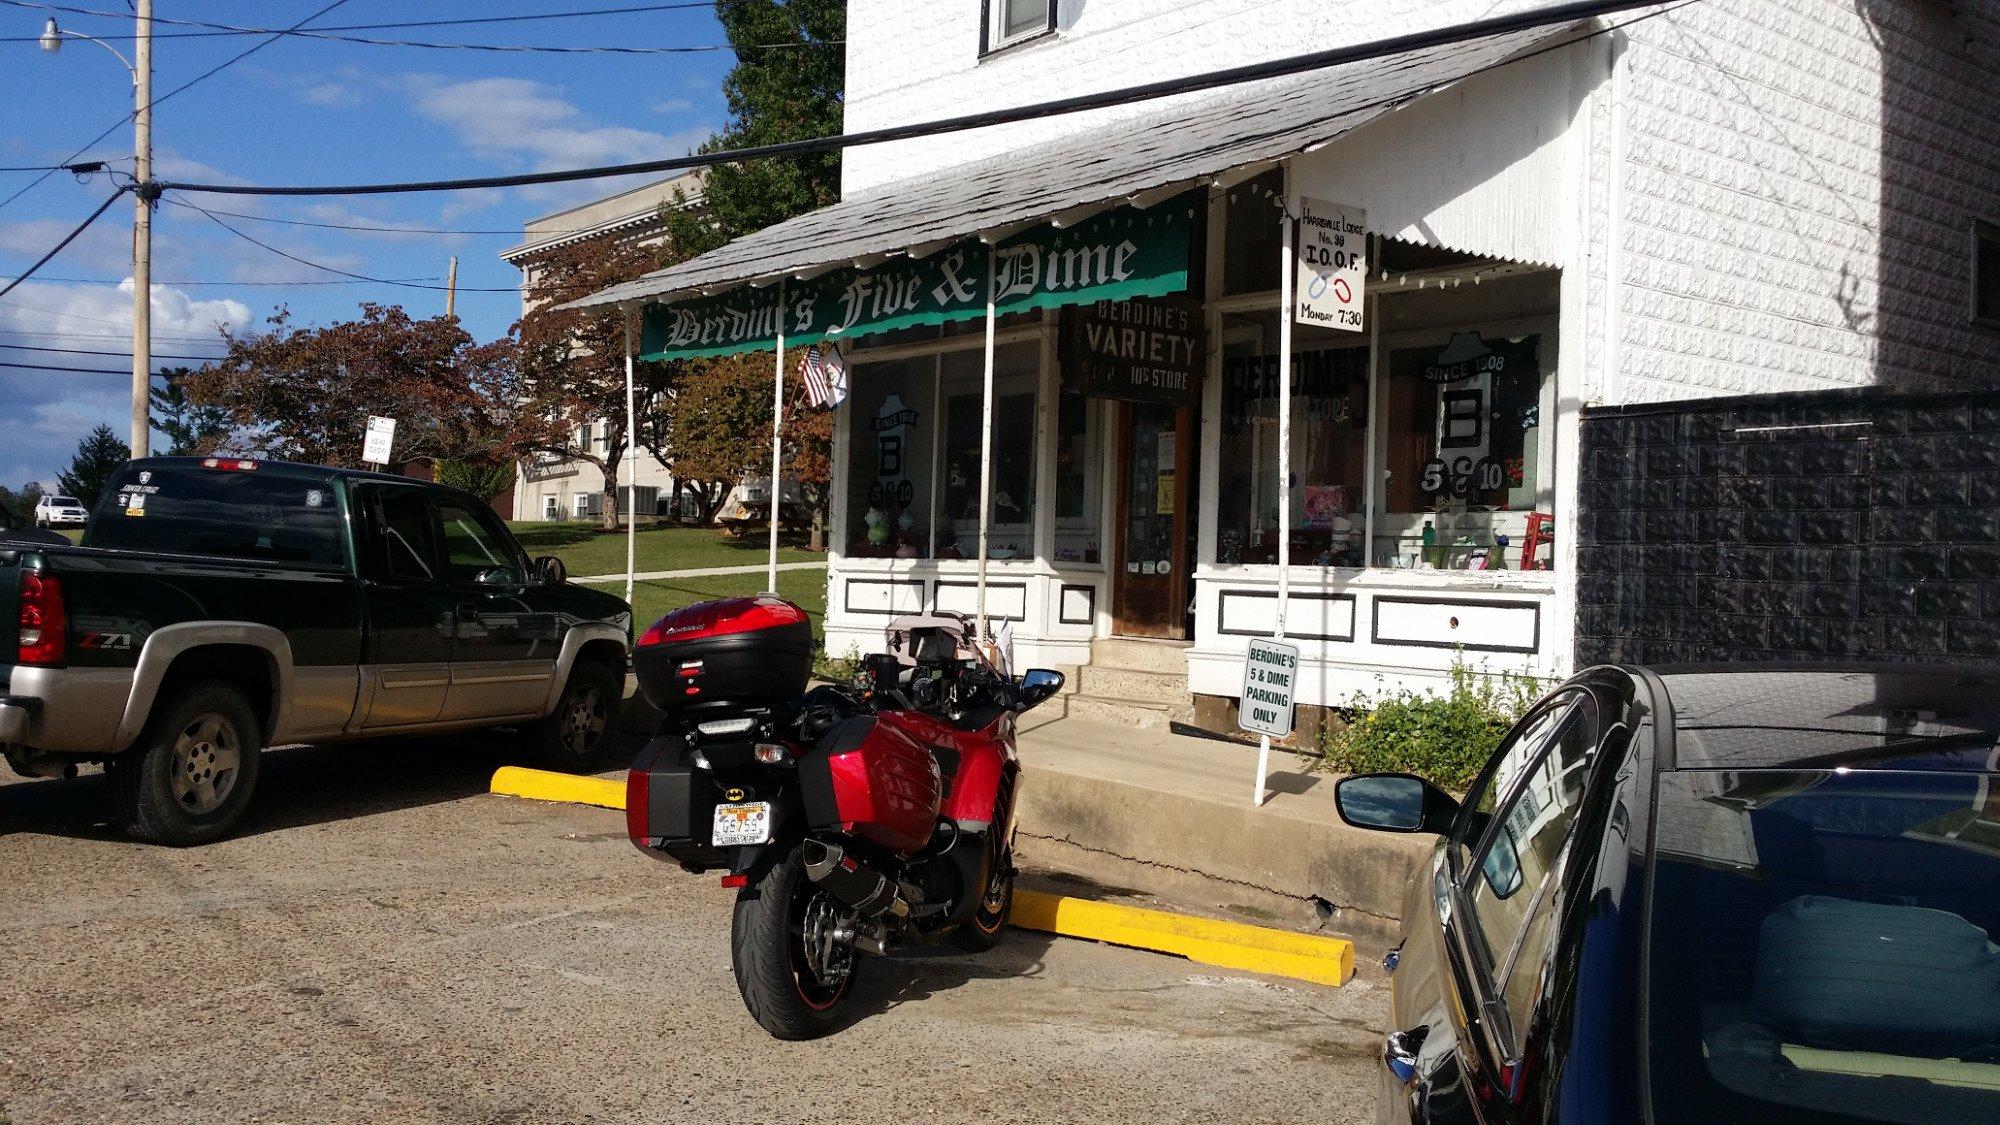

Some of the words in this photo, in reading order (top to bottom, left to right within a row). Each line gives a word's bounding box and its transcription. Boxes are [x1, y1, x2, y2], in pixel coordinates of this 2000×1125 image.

[826, 271, 922, 336] Five
[931, 249, 978, 307] &
[994, 238, 1138, 302] Dime
[1098, 300, 1189, 331] BERDINE'S
[1337, 308, 1362, 326] 7:30
[1086, 322, 1197, 367] VARIETY
[1424, 364, 1469, 382] SINCE
[1475, 354, 1505, 371] 1908
[1151, 368, 1189, 391] STORE
[369, 419, 375, 428] 2
[875, 415, 898, 430] SINCE
[1440, 389, 1484, 449] B
[879, 435, 902, 476] B
[1421, 460, 1445, 492] 5
[1480, 462, 1503, 490] 10
[900, 486, 912, 501] 10
[79, 632, 131, 648] Z71
[1250, 647, 1295, 669] BERDINE'S
[1250, 668, 1257, 680] 5
[1258, 669, 1266, 682] &
[1267, 671, 1289, 687] DIME
[1246, 686, 1288, 707] PARKING
[1253, 707, 1278, 724] ONLY
